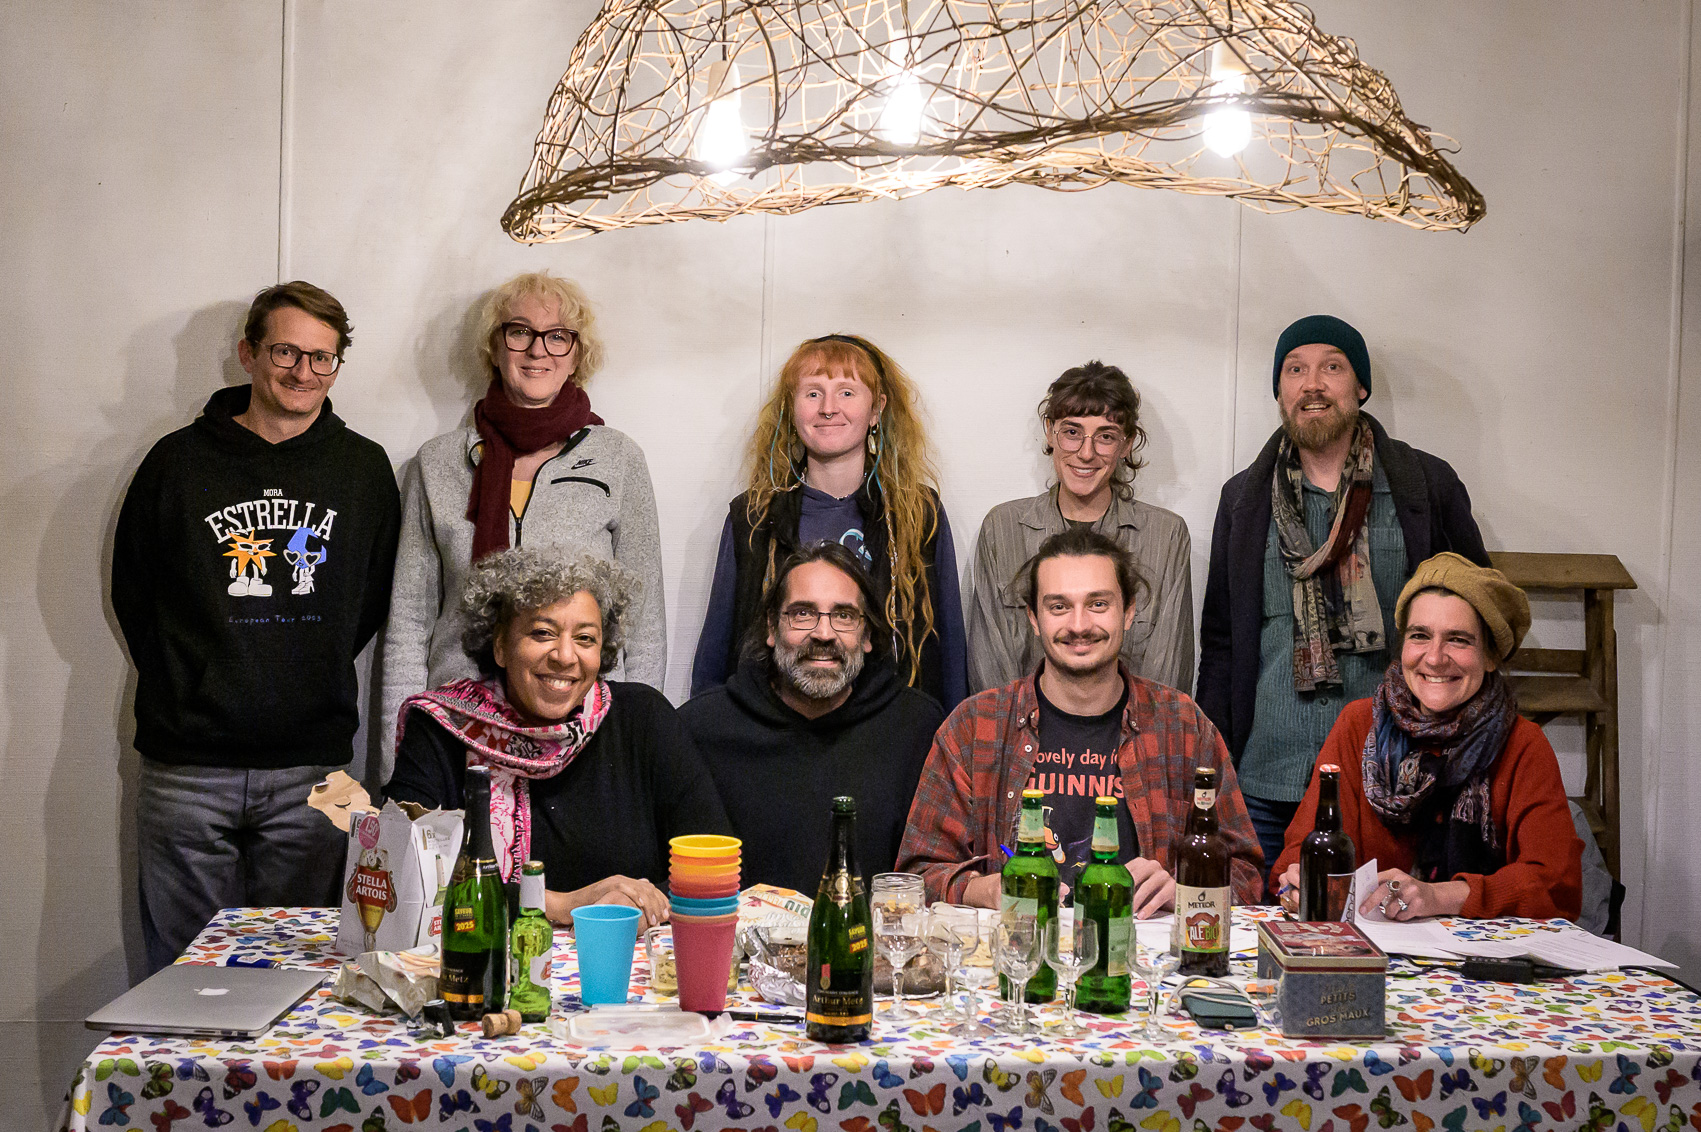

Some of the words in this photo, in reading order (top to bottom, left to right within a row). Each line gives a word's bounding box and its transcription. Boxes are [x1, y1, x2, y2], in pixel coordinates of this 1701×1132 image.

[263, 488, 283, 497] MORA
[204, 499, 338, 544] ESTRELLA
[1035, 747, 1076, 769] ovely
[1080, 748, 1107, 770] day
[357, 873, 388, 889] STELLA
[356, 885, 388, 901] ARTOIS
[1187, 901, 1216, 909] METEOR
[1190, 925, 1205, 941] ALE
[1205, 924, 1220, 940] BIO
[1320, 992, 1357, 1005] PETITS
[1306, 1014, 1338, 1027] GROS
[1339, 1008, 1371, 1022] MAUX
